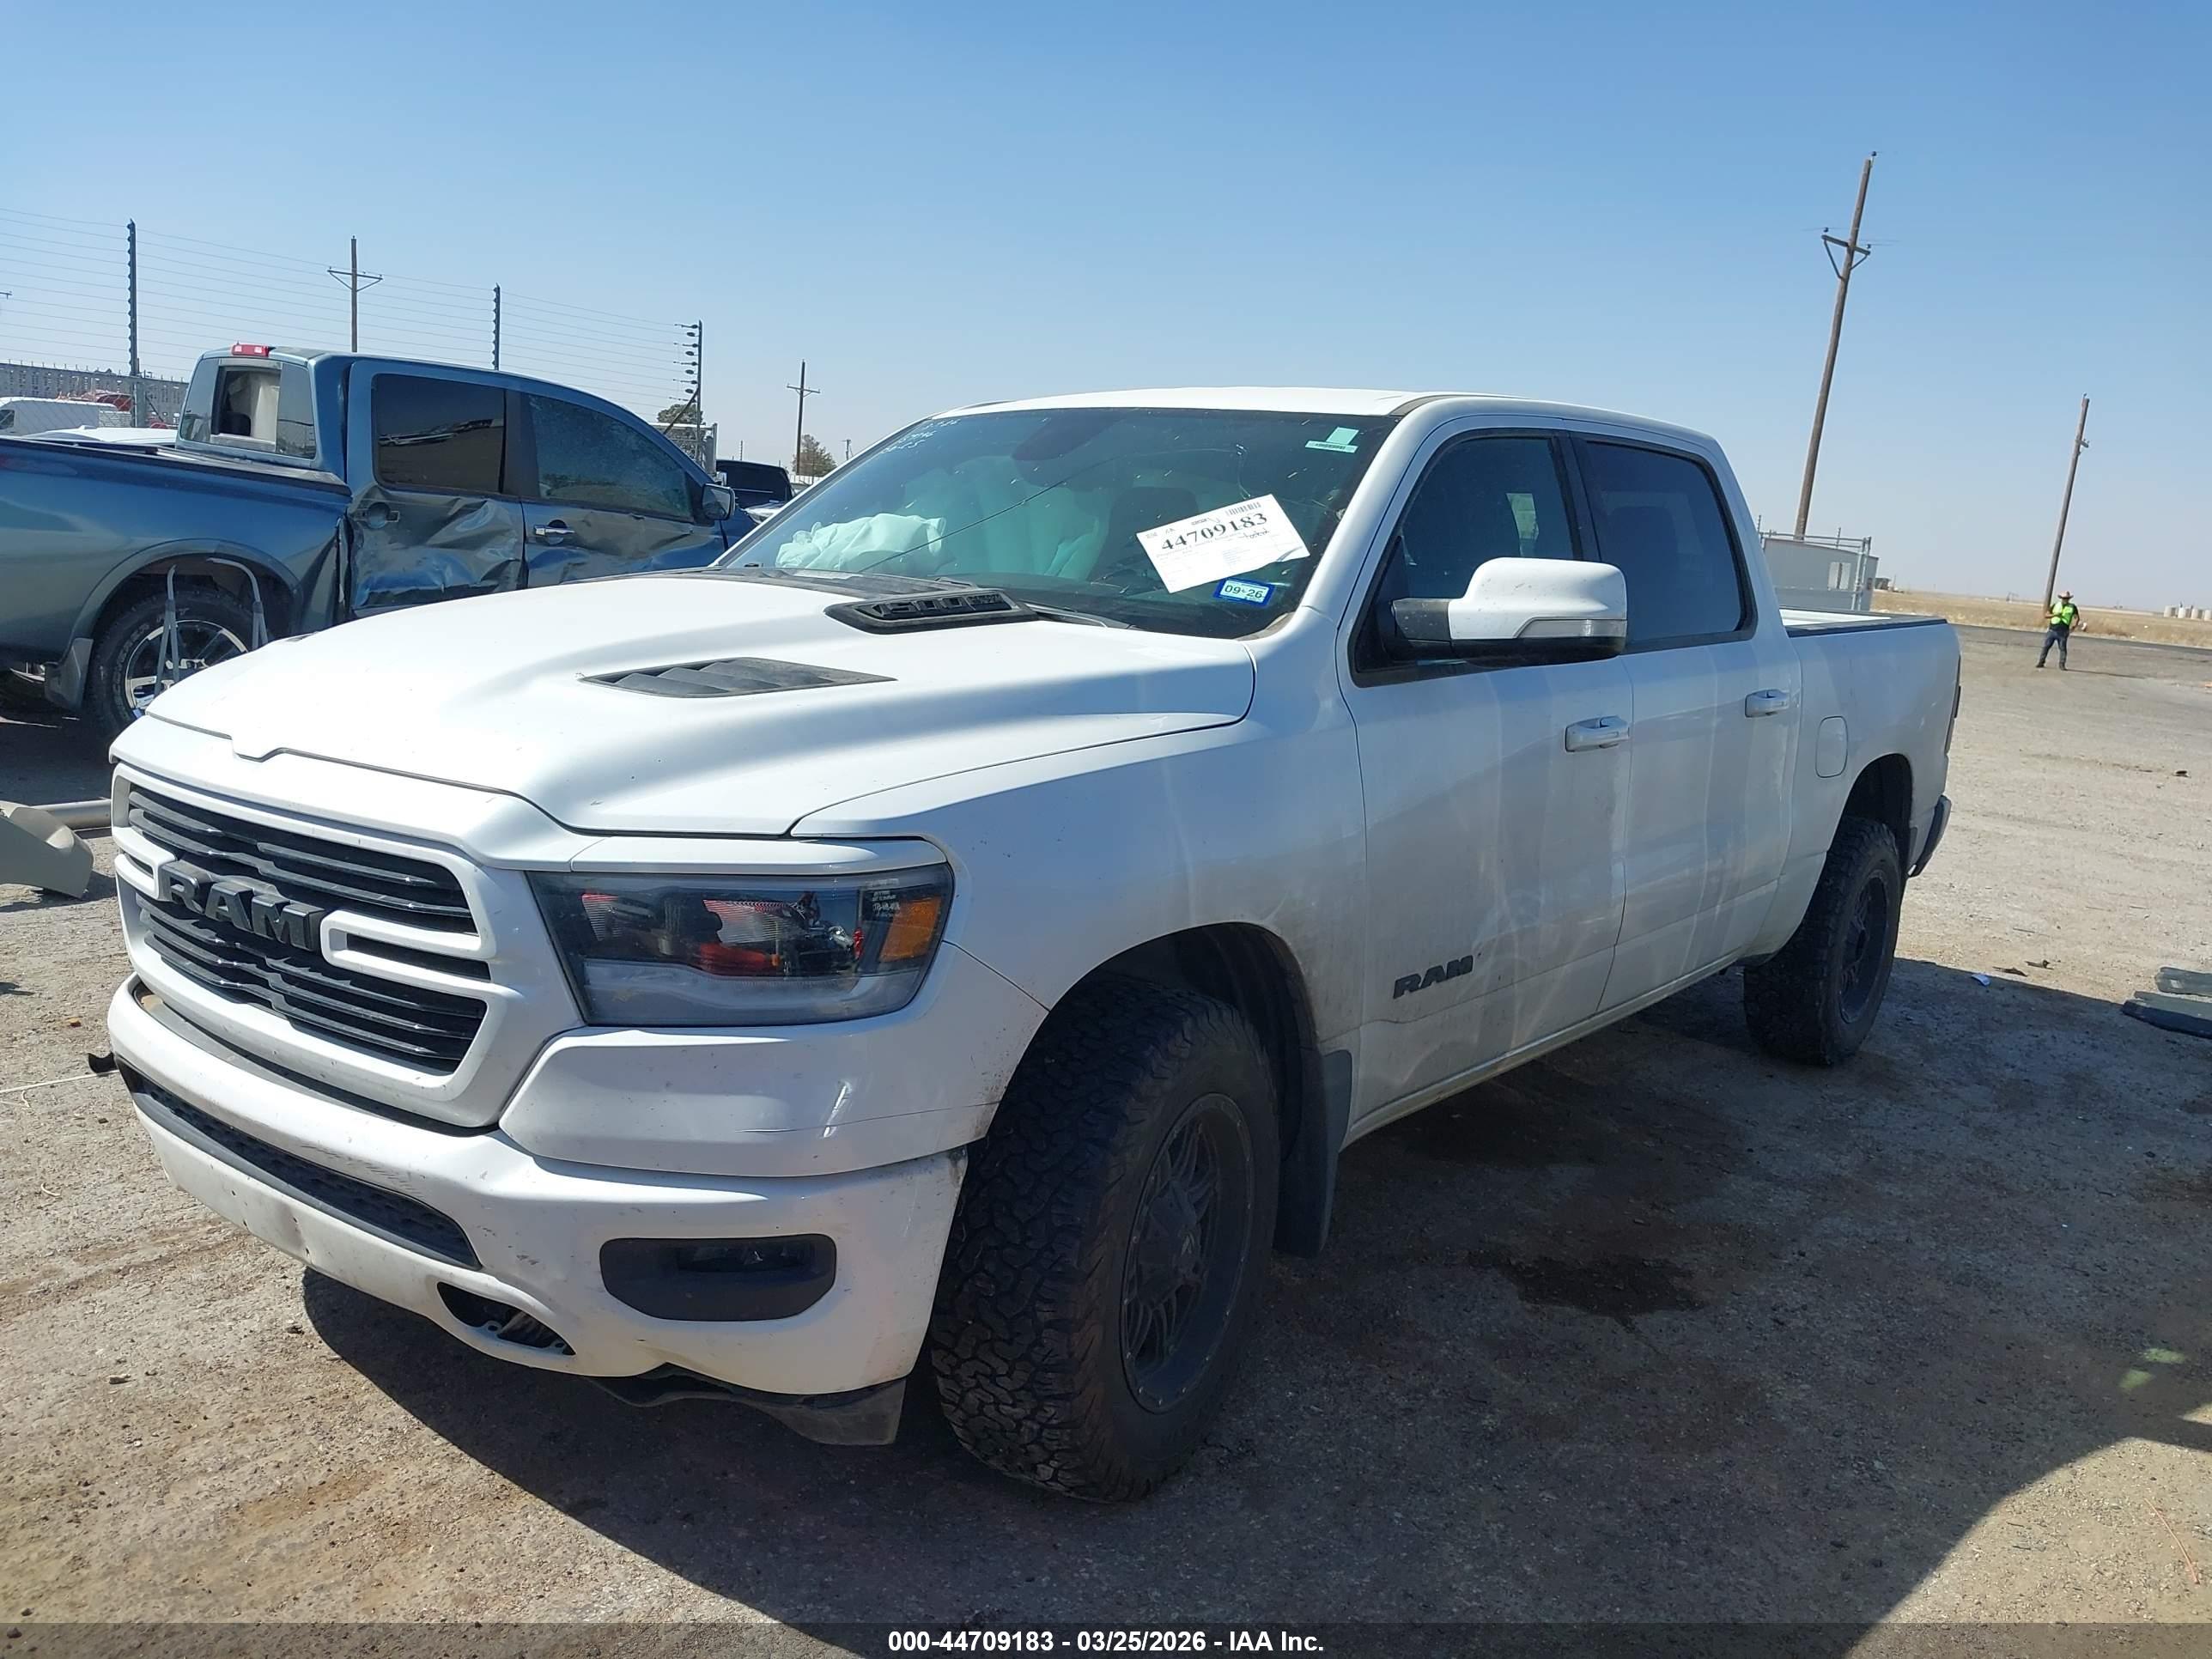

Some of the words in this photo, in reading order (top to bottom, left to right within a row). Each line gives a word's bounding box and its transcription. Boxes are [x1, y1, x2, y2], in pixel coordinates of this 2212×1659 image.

[1161, 513, 1268, 550] 44709183
[158, 860, 325, 951] RAM
[1393, 955, 1474, 1000] RAM
